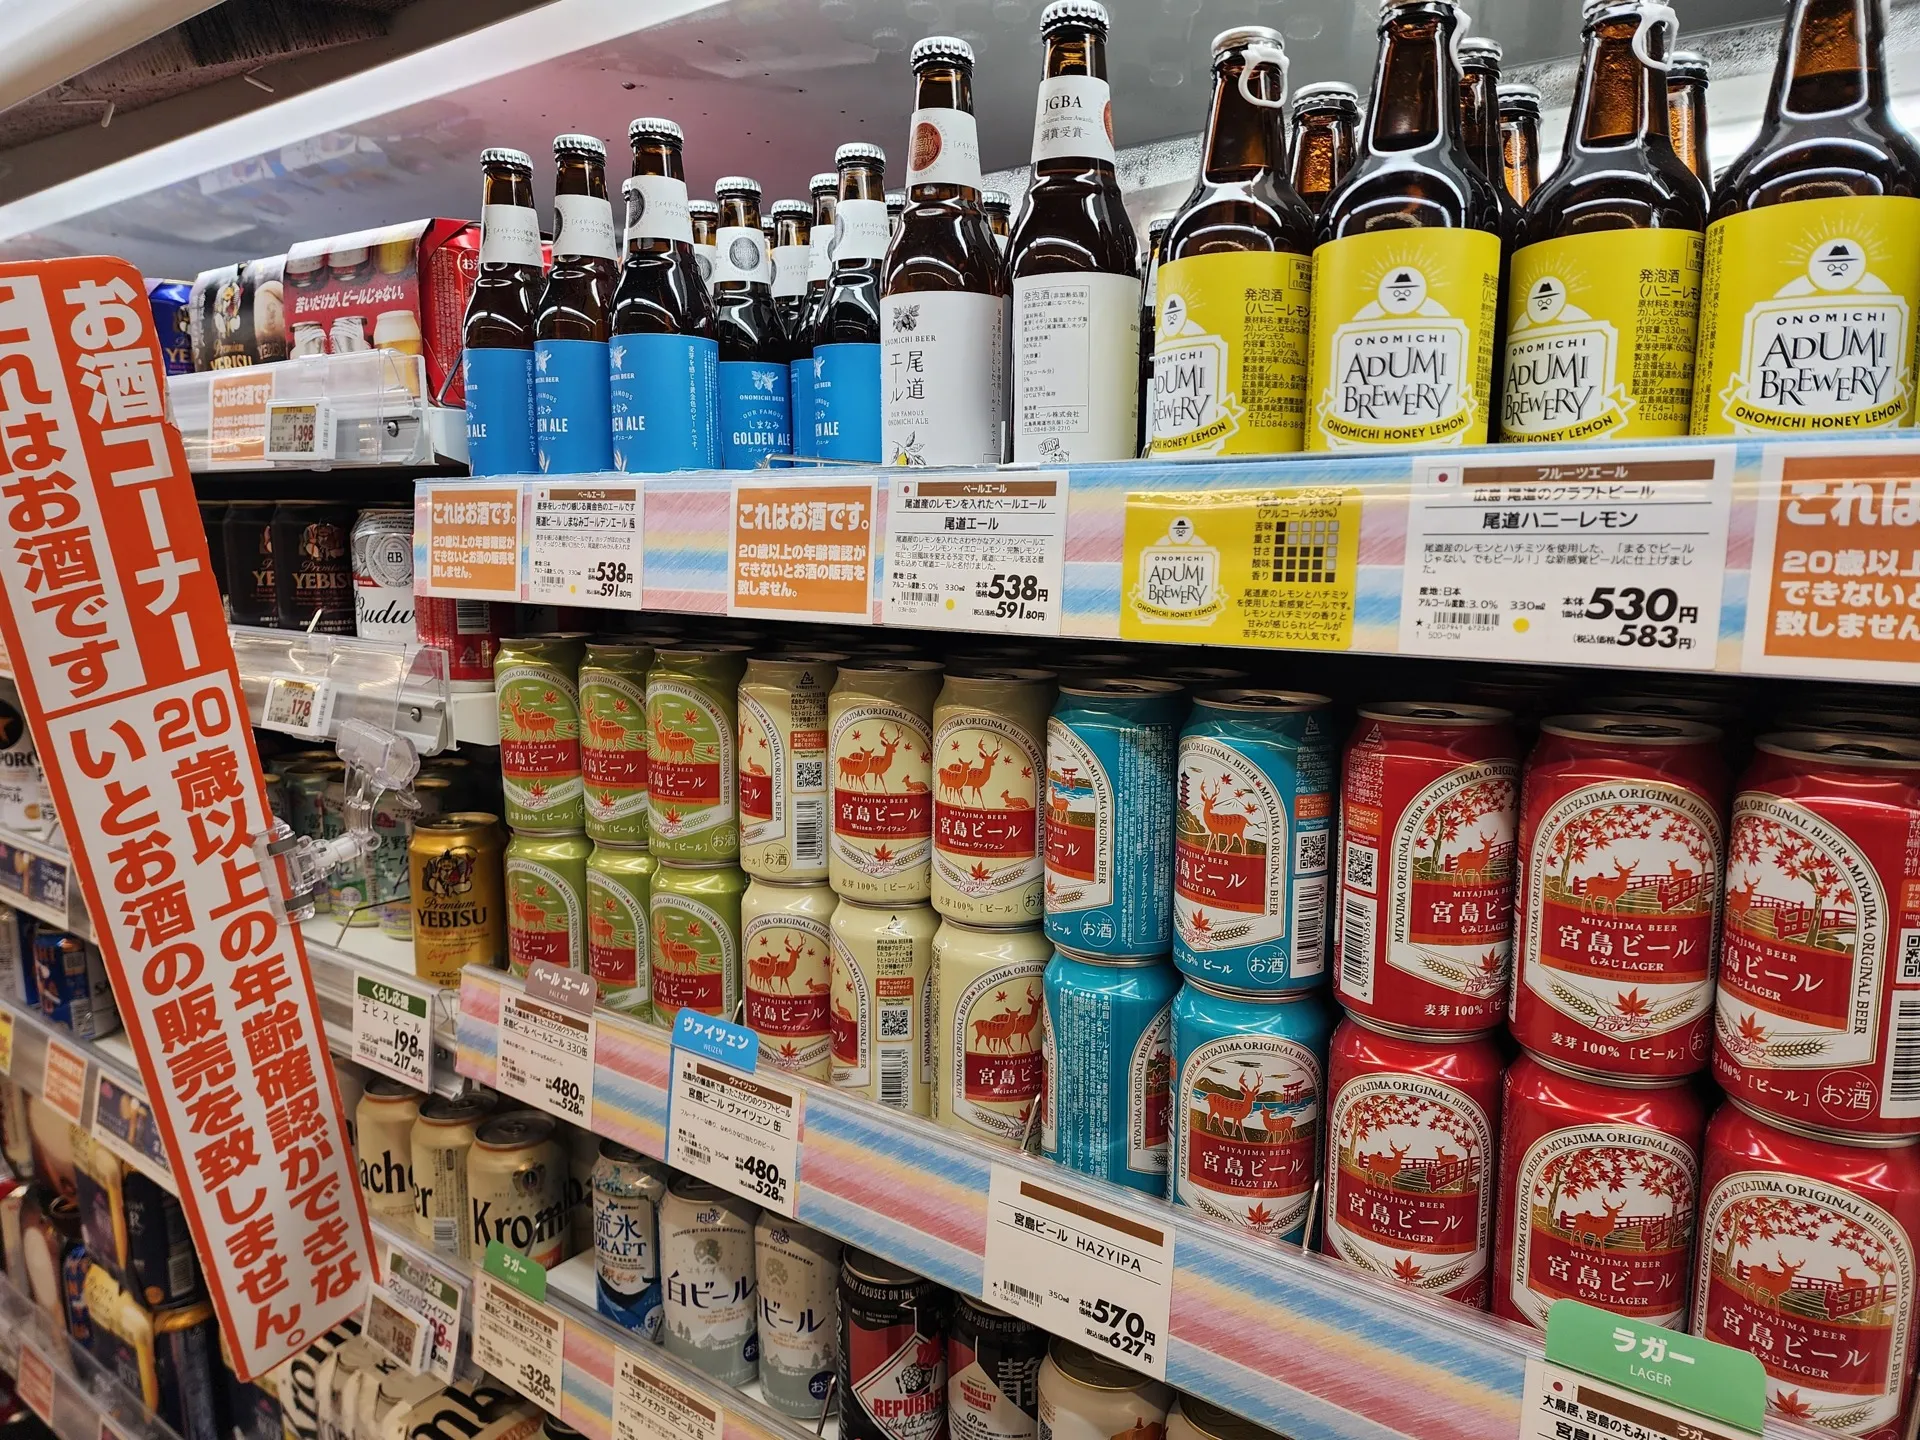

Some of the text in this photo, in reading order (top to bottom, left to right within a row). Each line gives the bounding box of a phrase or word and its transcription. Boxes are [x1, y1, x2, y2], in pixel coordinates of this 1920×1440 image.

[1044, 94, 1083, 116] JGBA
[1639, 269, 1680, 285] 発泡酒
[295, 284, 406, 314] 苦いだけが、ビールじゃない。
[1244, 288, 1283, 302] 発泡酒
[1776, 311, 1888, 326] ONOMICHI
[1354, 334, 1447, 346] ONOMICHI
[1511, 338, 1588, 356] ONOMICHI
[1759, 326, 1887, 370] ADUMI
[906, 350, 926, 400] 尾道
[1343, 346, 1448, 385] ADUMI
[1506, 352, 1590, 393] ADUMI
[889, 352, 905, 405] エール
[1758, 365, 1894, 407] BREWERY
[739, 393, 785, 403] ONOMICHI BEER
[1342, 383, 1452, 419] BREWERY
[1504, 385, 1597, 427] BREWERY
[626, 415, 646, 432] ALE
[741, 409, 784, 420] OUR FAMOUS
[1735, 402, 1902, 430] ONOMICHI HONEY LEMON
[549, 417, 568, 433] ALE
[748, 419, 781, 430] しまなみ
[1326, 415, 1466, 440] ONOMICHI HONEY LEMON
[732, 431, 791, 446] GOLDEN ALE
[64, 277, 202, 672] お酒コーナー
[1537, 466, 1629, 481] フルーツエール
[963, 484, 1008, 494] ペールエール
[1507, 485, 1656, 502] 尾道のクラフトビール
[433, 500, 517, 527] これはお酒です。
[904, 499, 1047, 510] 尾道産のレモンを入れたペールエール
[536, 516, 562, 527] 尾道ビール
[563, 516, 628, 528] しまなみゴールデンエール
[739, 502, 870, 532] これはお酒です。
[944, 517, 999, 531] 尾道エール
[1255, 521, 1273, 532] 苦味
[1482, 511, 1640, 530] 尾道ハニーレモン
[1253, 534, 1271, 544] 重さ
[1424, 542, 1695, 555] 尾道産のレモンとハチミツを使用した、「まるでビール
[738, 544, 866, 561] 20歳以上の年齢確認が
[1253, 547, 1271, 556] 甘さ
[738, 564, 865, 582] できないとお酒の販売を
[1148, 562, 1204, 584] ADUMI
[1251, 559, 1271, 568] 酸味
[1422, 564, 1437, 575] た。
[1251, 571, 1269, 581] 香り
[737, 581, 798, 598] 致しません。
[987, 574, 1049, 602] 538円
[1148, 583, 1208, 606] BREWERY
[1244, 588, 1349, 599] 尾道産のレモンとハチミツ
[1420, 587, 1461, 596] 産地:日本
[1236, 599, 1352, 611] を使用した新感覚ビールです。
[1562, 597, 1585, 606] 本体
[1584, 586, 1699, 624] 530円
[1243, 609, 1348, 621] レモンとハチミツの香りと
[1242, 629, 1341, 642] 苦手な方にも大人気です。
[291, 699, 311, 717] 178
[939, 816, 1023, 840] 宮島ビール
[423, 898, 476, 911] Premium
[417, 908, 488, 928] YEBISU
[1581, 917, 1678, 932] MIYAJIMA BEER
[1082, 922, 1113, 938] お酒
[1557, 924, 1697, 958] 宮島ビール
[1203, 959, 1233, 974] ビール
[1250, 957, 1284, 974] お酒
[534, 968, 590, 997] ペール エール
[153, 684, 362, 1306] 20歳以上の年齢確認ができな
[1424, 1003, 1484, 1016] 麦芽 100%
[69, 718, 306, 1351] いとお酒の販売を致しません。
[683, 1016, 749, 1050] ヴァイツェン
[394, 1028, 425, 1061] 198円
[703, 1043, 723, 1057] WEIZEN
[1551, 1031, 1685, 1060] 麦芽 100% [ビール]
[728, 1076, 758, 1093] ヴァイツェン
[1718, 1061, 1810, 1107] 100% [ビール]
[1821, 1083, 1871, 1110] お酒
[688, 1087, 782, 1133] 宮島ビール ヴァイツェン 缶
[743, 1155, 787, 1190] 480円
[1202, 1151, 1304, 1178] 宮島ビール
[1230, 1178, 1279, 1188] HAZY IPA
[1347, 1191, 1463, 1233] 宮島ビール
[1726, 1180, 1893, 1239] MIYAJIMA ORIGINAL BEER
[597, 1212, 642, 1242] 流氷
[595, 1239, 647, 1258] DRAFT
[1014, 1212, 1141, 1272] 宮島ビール HAZYIPA
[502, 1254, 527, 1275] ラガー
[1570, 1249, 1662, 1268] MIYAJIMA BEER
[1547, 1254, 1676, 1292] 宮島ビール
[667, 1269, 756, 1310] 白ビール
[1091, 1298, 1156, 1347] 570円
[1742, 1302, 1847, 1342] MIYAJIMA BEER
[1611, 1325, 1696, 1367] ラガー
[1720, 1304, 1871, 1370] 宮島ビール
[1630, 1364, 1673, 1387] LAGER
[982, 1393, 997, 1403] CITY
[668, 1410, 694, 1434] 白ビール
[966, 1411, 988, 1430] 69 IPA
